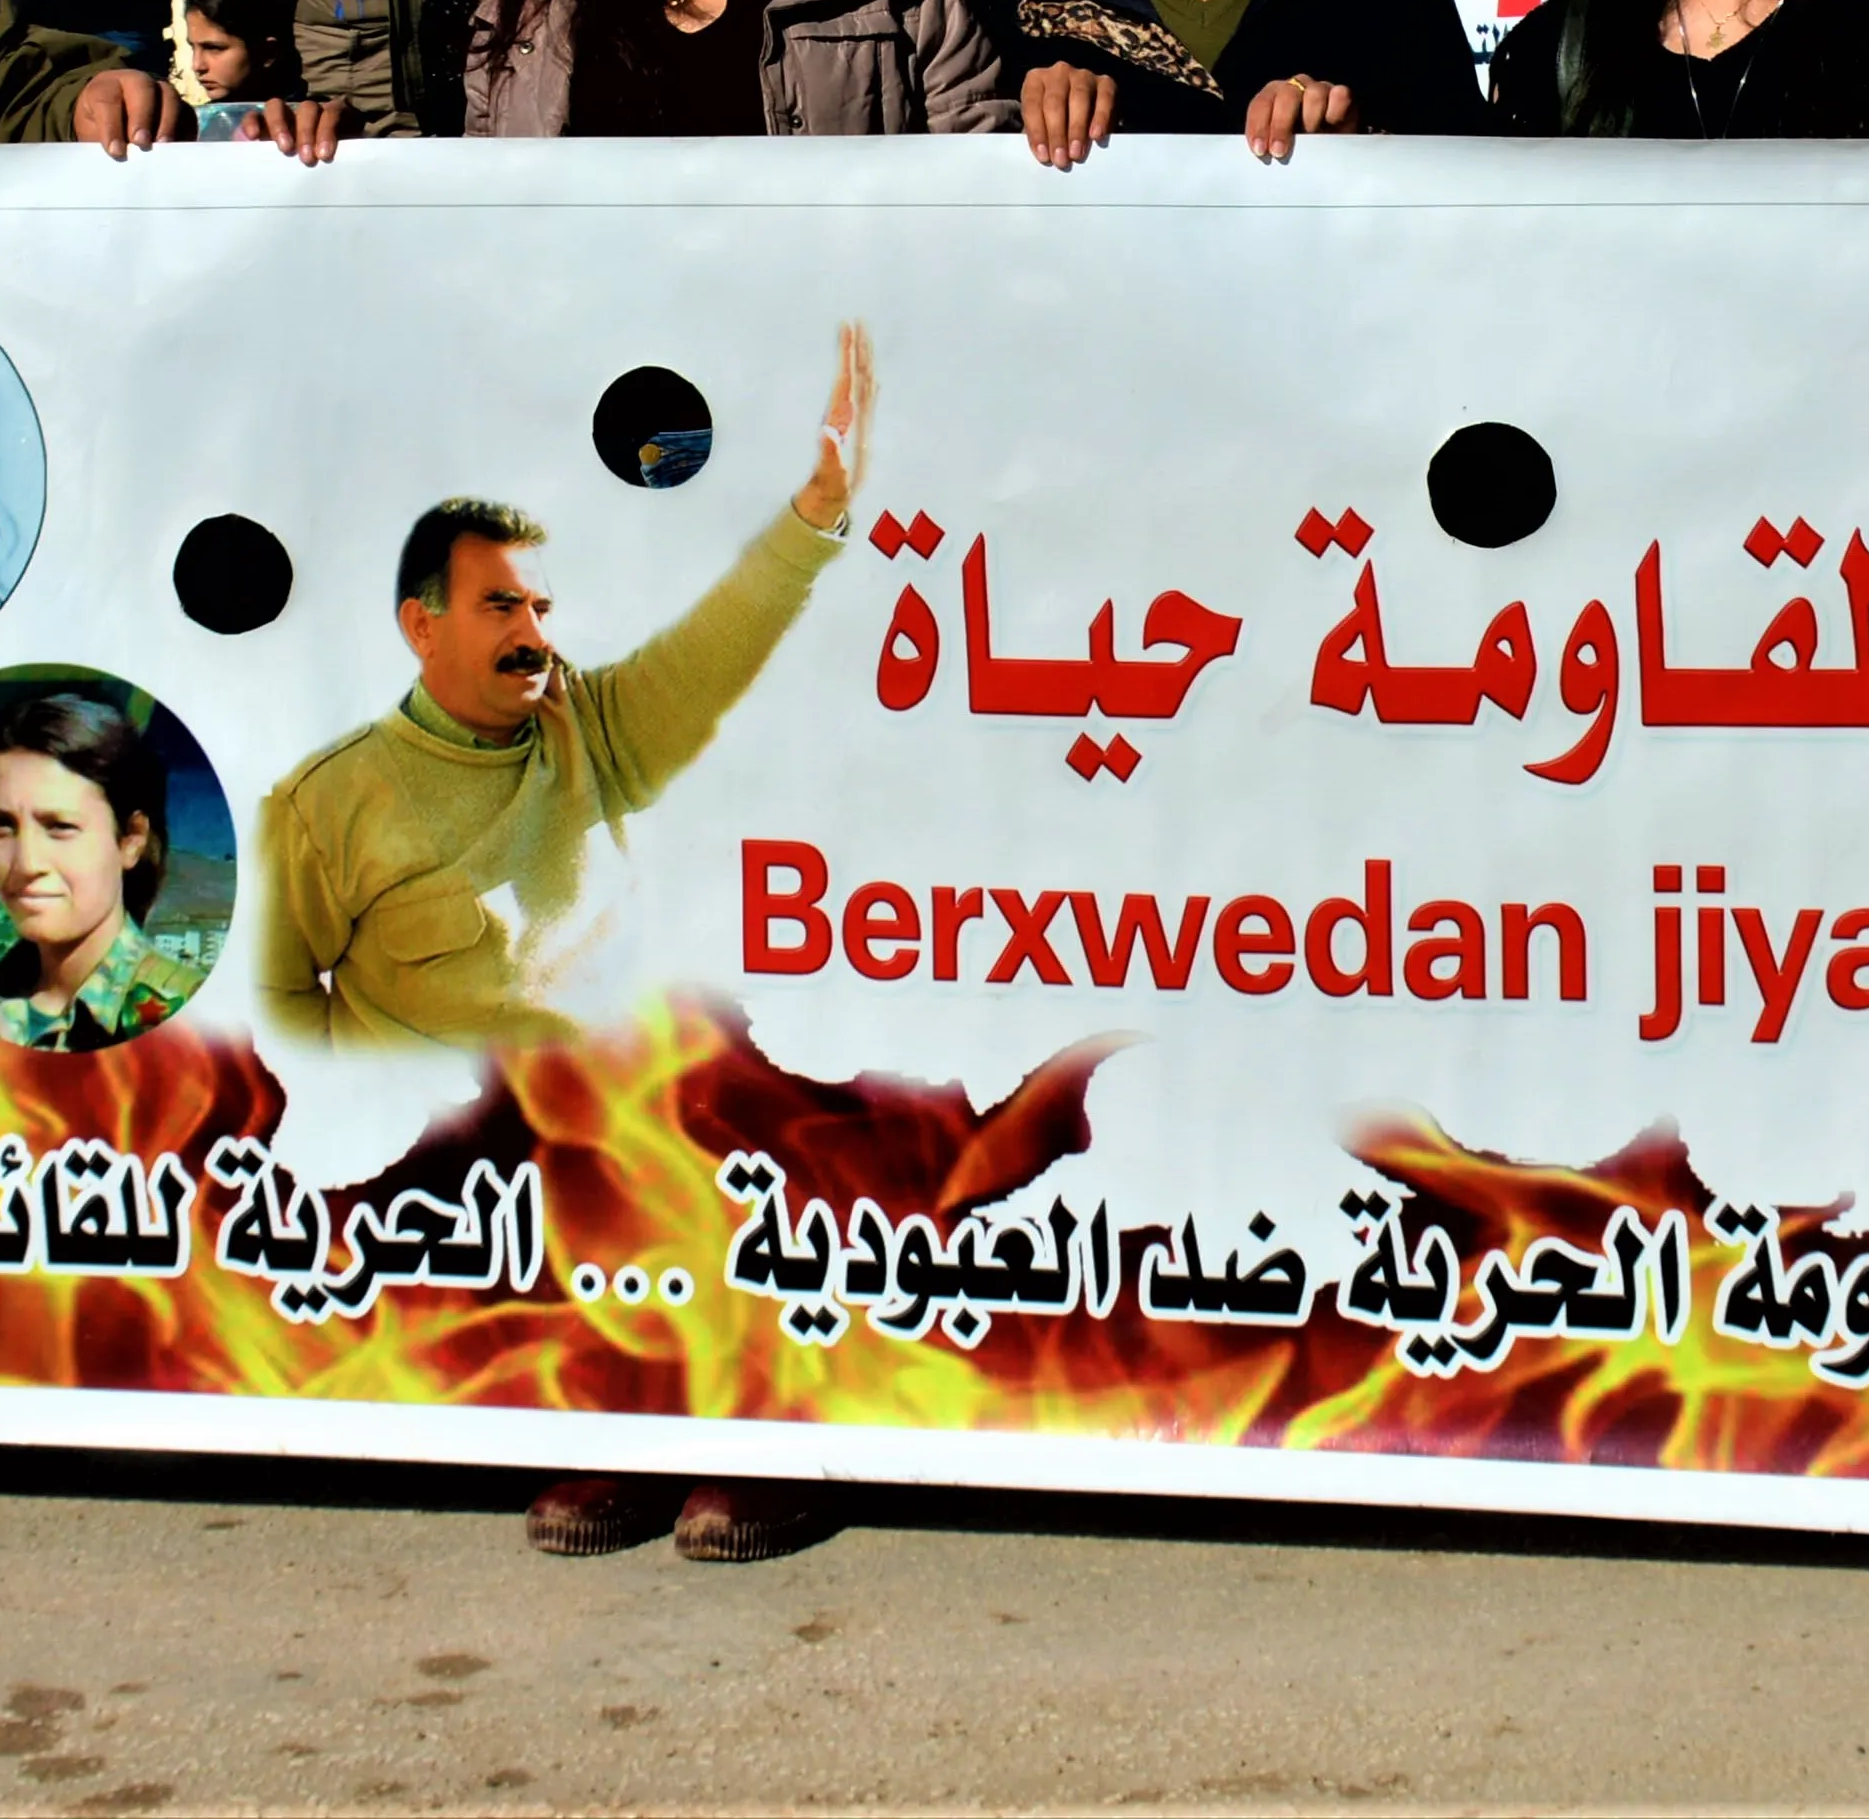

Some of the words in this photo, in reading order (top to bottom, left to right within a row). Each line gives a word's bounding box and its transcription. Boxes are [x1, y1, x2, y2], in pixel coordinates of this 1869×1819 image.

[868, 508, 1244, 782] حياة
[740, 838, 1588, 1002] Berxwedan
[211, 1148, 536, 1319] الحرية
[728, 1161, 1111, 1338] العبودية
[1148, 1210, 1308, 1316] ضد
[1339, 1189, 1680, 1367] الحرية
